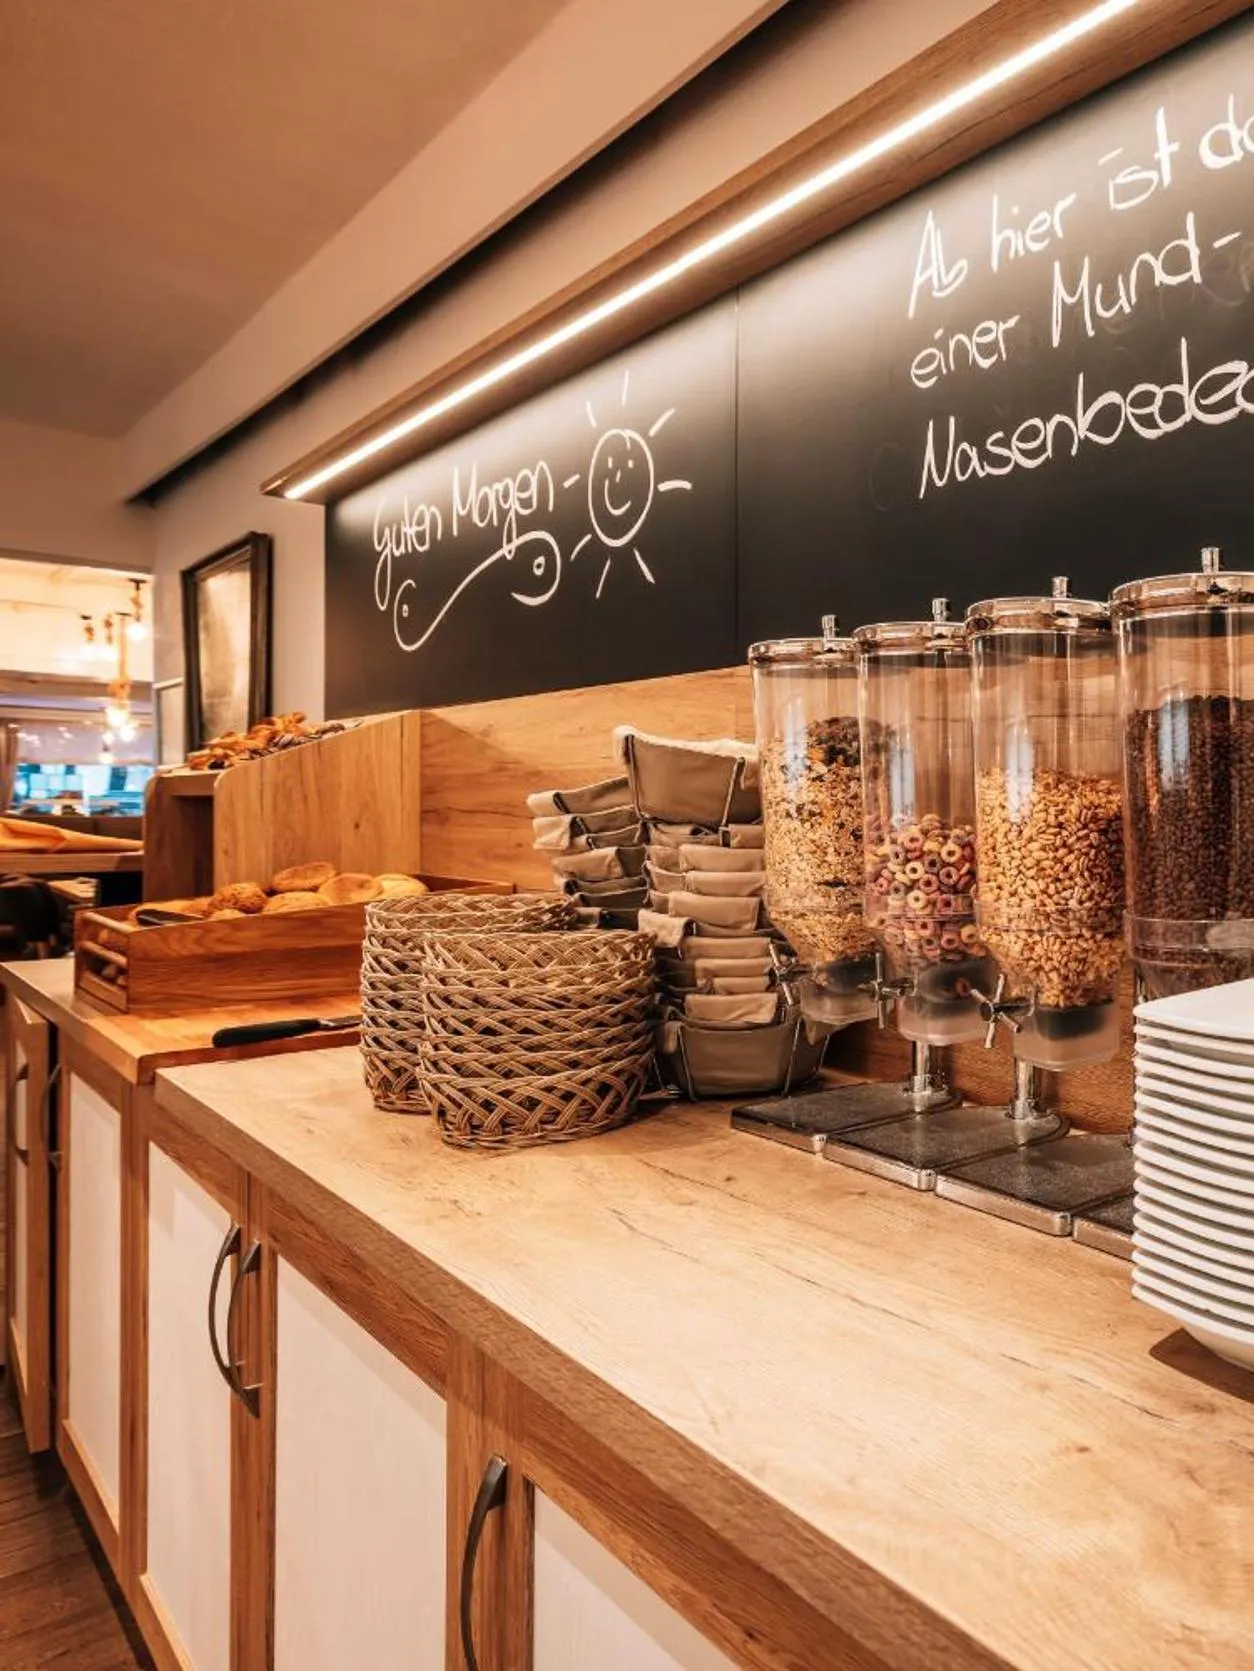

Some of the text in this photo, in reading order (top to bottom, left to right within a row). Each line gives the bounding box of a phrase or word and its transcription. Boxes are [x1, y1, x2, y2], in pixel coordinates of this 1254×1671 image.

[908, 211, 968, 318] Ab
[990, 193, 1077, 272] hier
[1099, 107, 1179, 210] ist
[910, 314, 1020, 389] einer
[452, 460, 554, 560] Morgen
